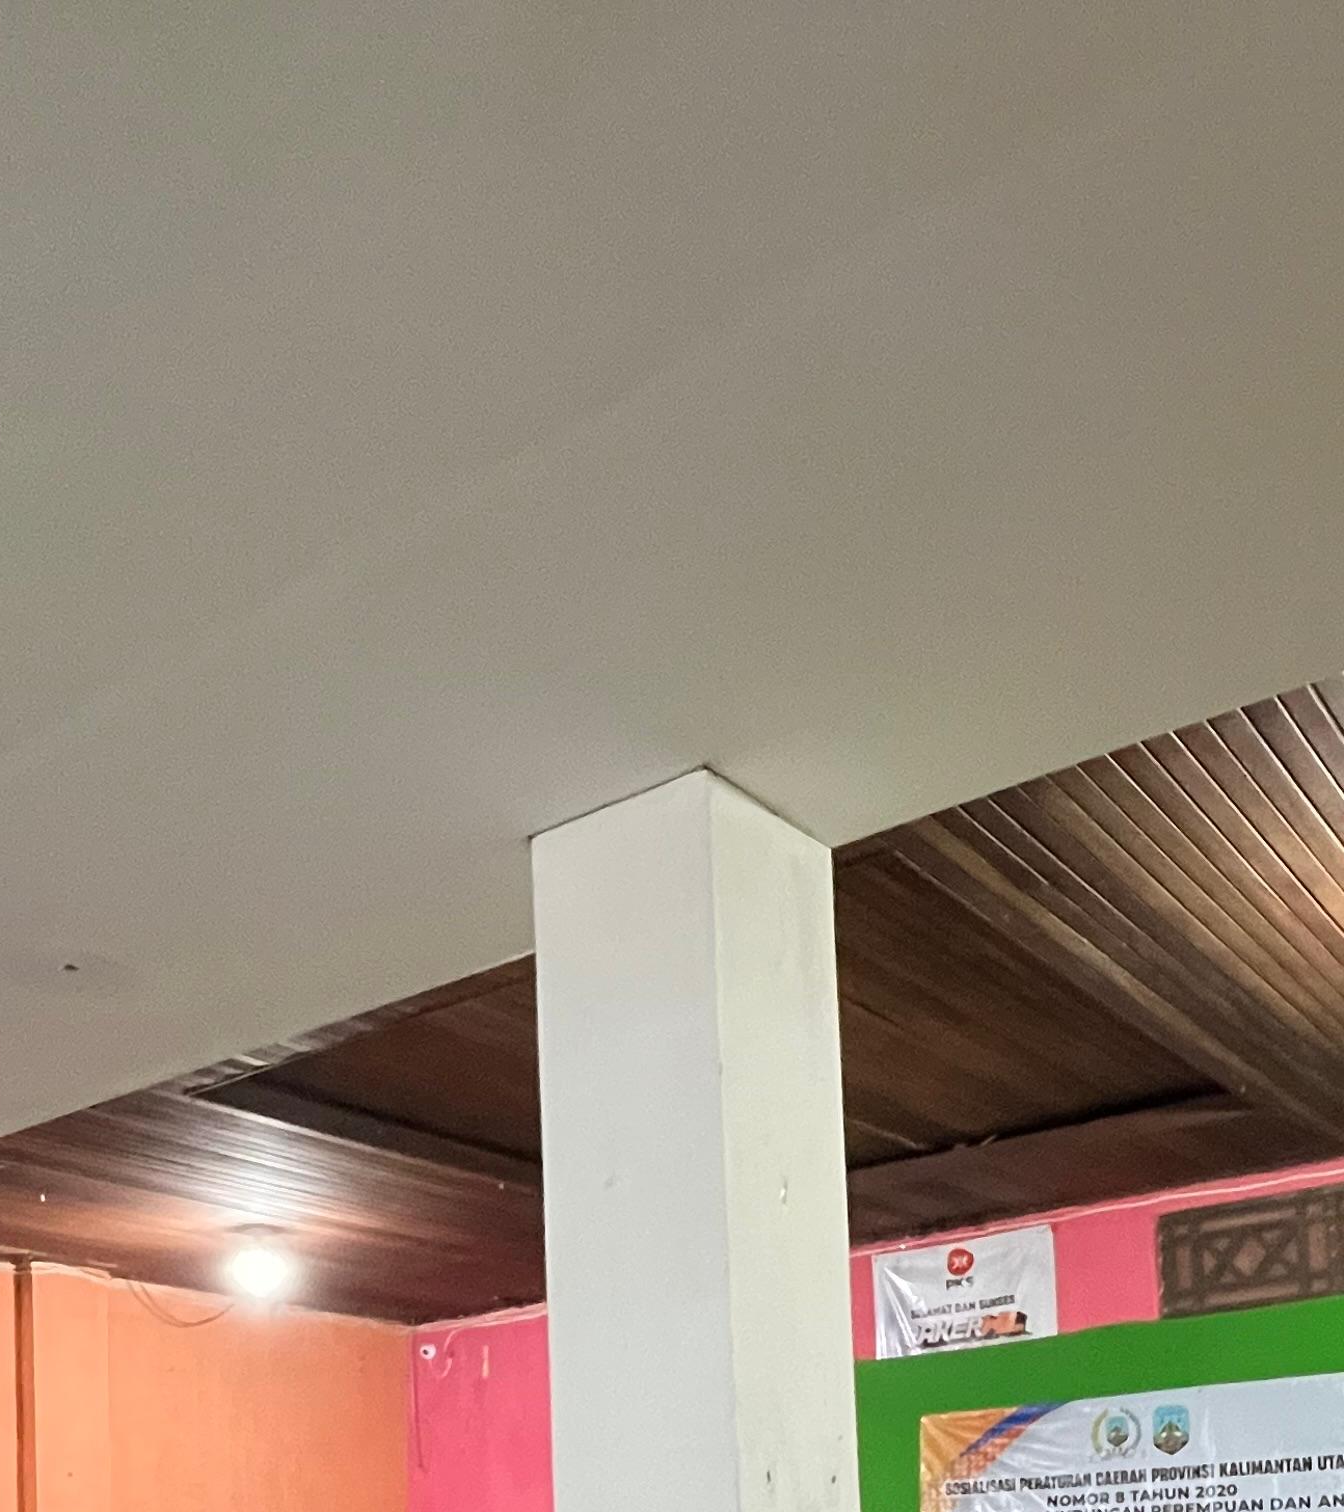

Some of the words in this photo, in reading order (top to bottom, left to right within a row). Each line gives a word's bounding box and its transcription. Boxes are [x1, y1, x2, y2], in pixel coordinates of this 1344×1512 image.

[945, 1477, 1016, 1496] SOSIALISASI
[1019, 1472, 1092, 1491] PERATURAN
[1095, 1468, 1147, 1487] DAERAH
[1151, 1464, 1215, 1483] PROVINSI
[1219, 1456, 1313, 1478] KALIMANTAN
[1047, 1491, 1110, 1507] NOMOR
[1115, 1491, 1125, 1504] 8
[1130, 1487, 1190, 1503] TAHUN
[1195, 1484, 1238, 1498] 2020
[1270, 1495, 1311, 1511] DAN
